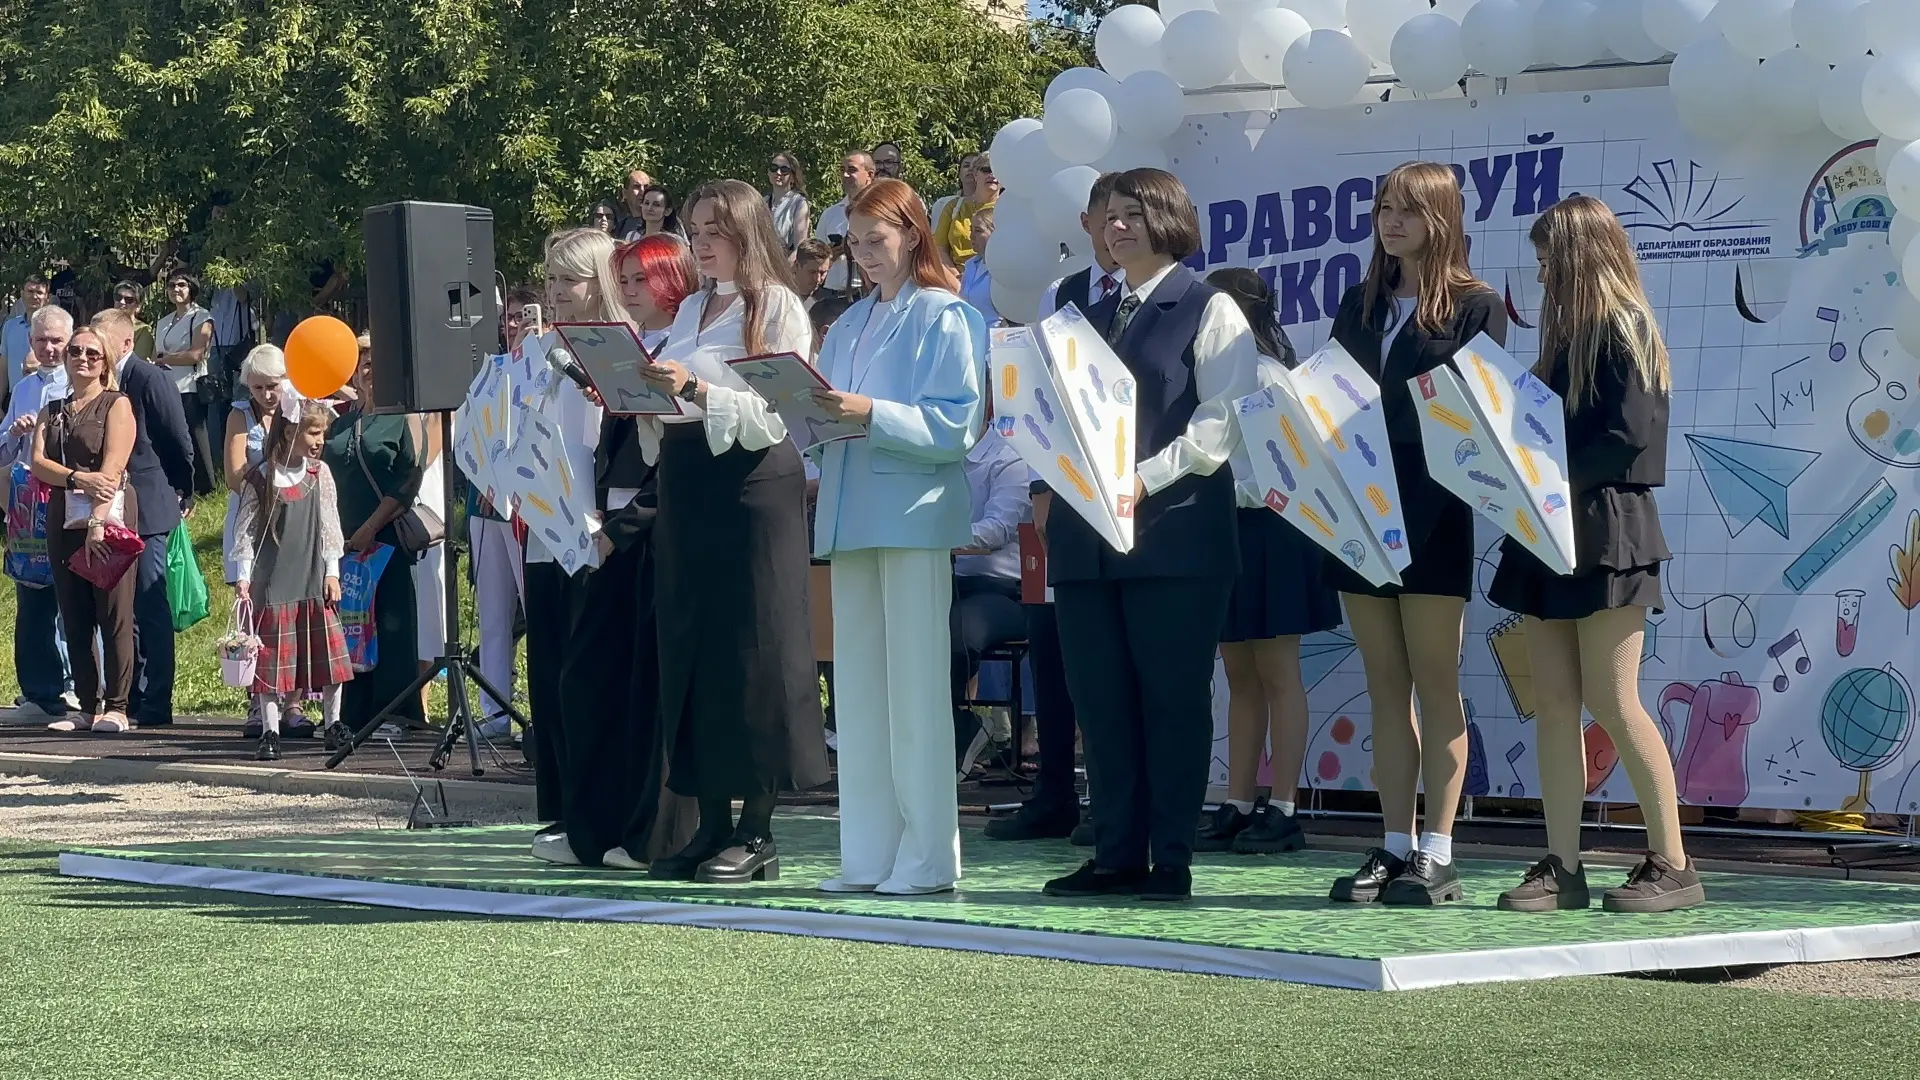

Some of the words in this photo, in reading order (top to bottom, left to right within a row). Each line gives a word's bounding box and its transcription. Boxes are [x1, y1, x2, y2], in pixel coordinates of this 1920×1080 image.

[1833, 221, 1857, 235] МБОУ
[1860, 220, 1880, 228] СОШ
[1636, 240, 1701, 251] ДЕПАРТАМЕНТ
[1703, 236, 1771, 247] ОБРАЗОВАНИЯ
[1636, 249, 1701, 260] АДМИНИСТРАЦИИ
[1701, 248, 1730, 258] ГОРОДА
[1732, 247, 1770, 257] ИРКУТСКА
